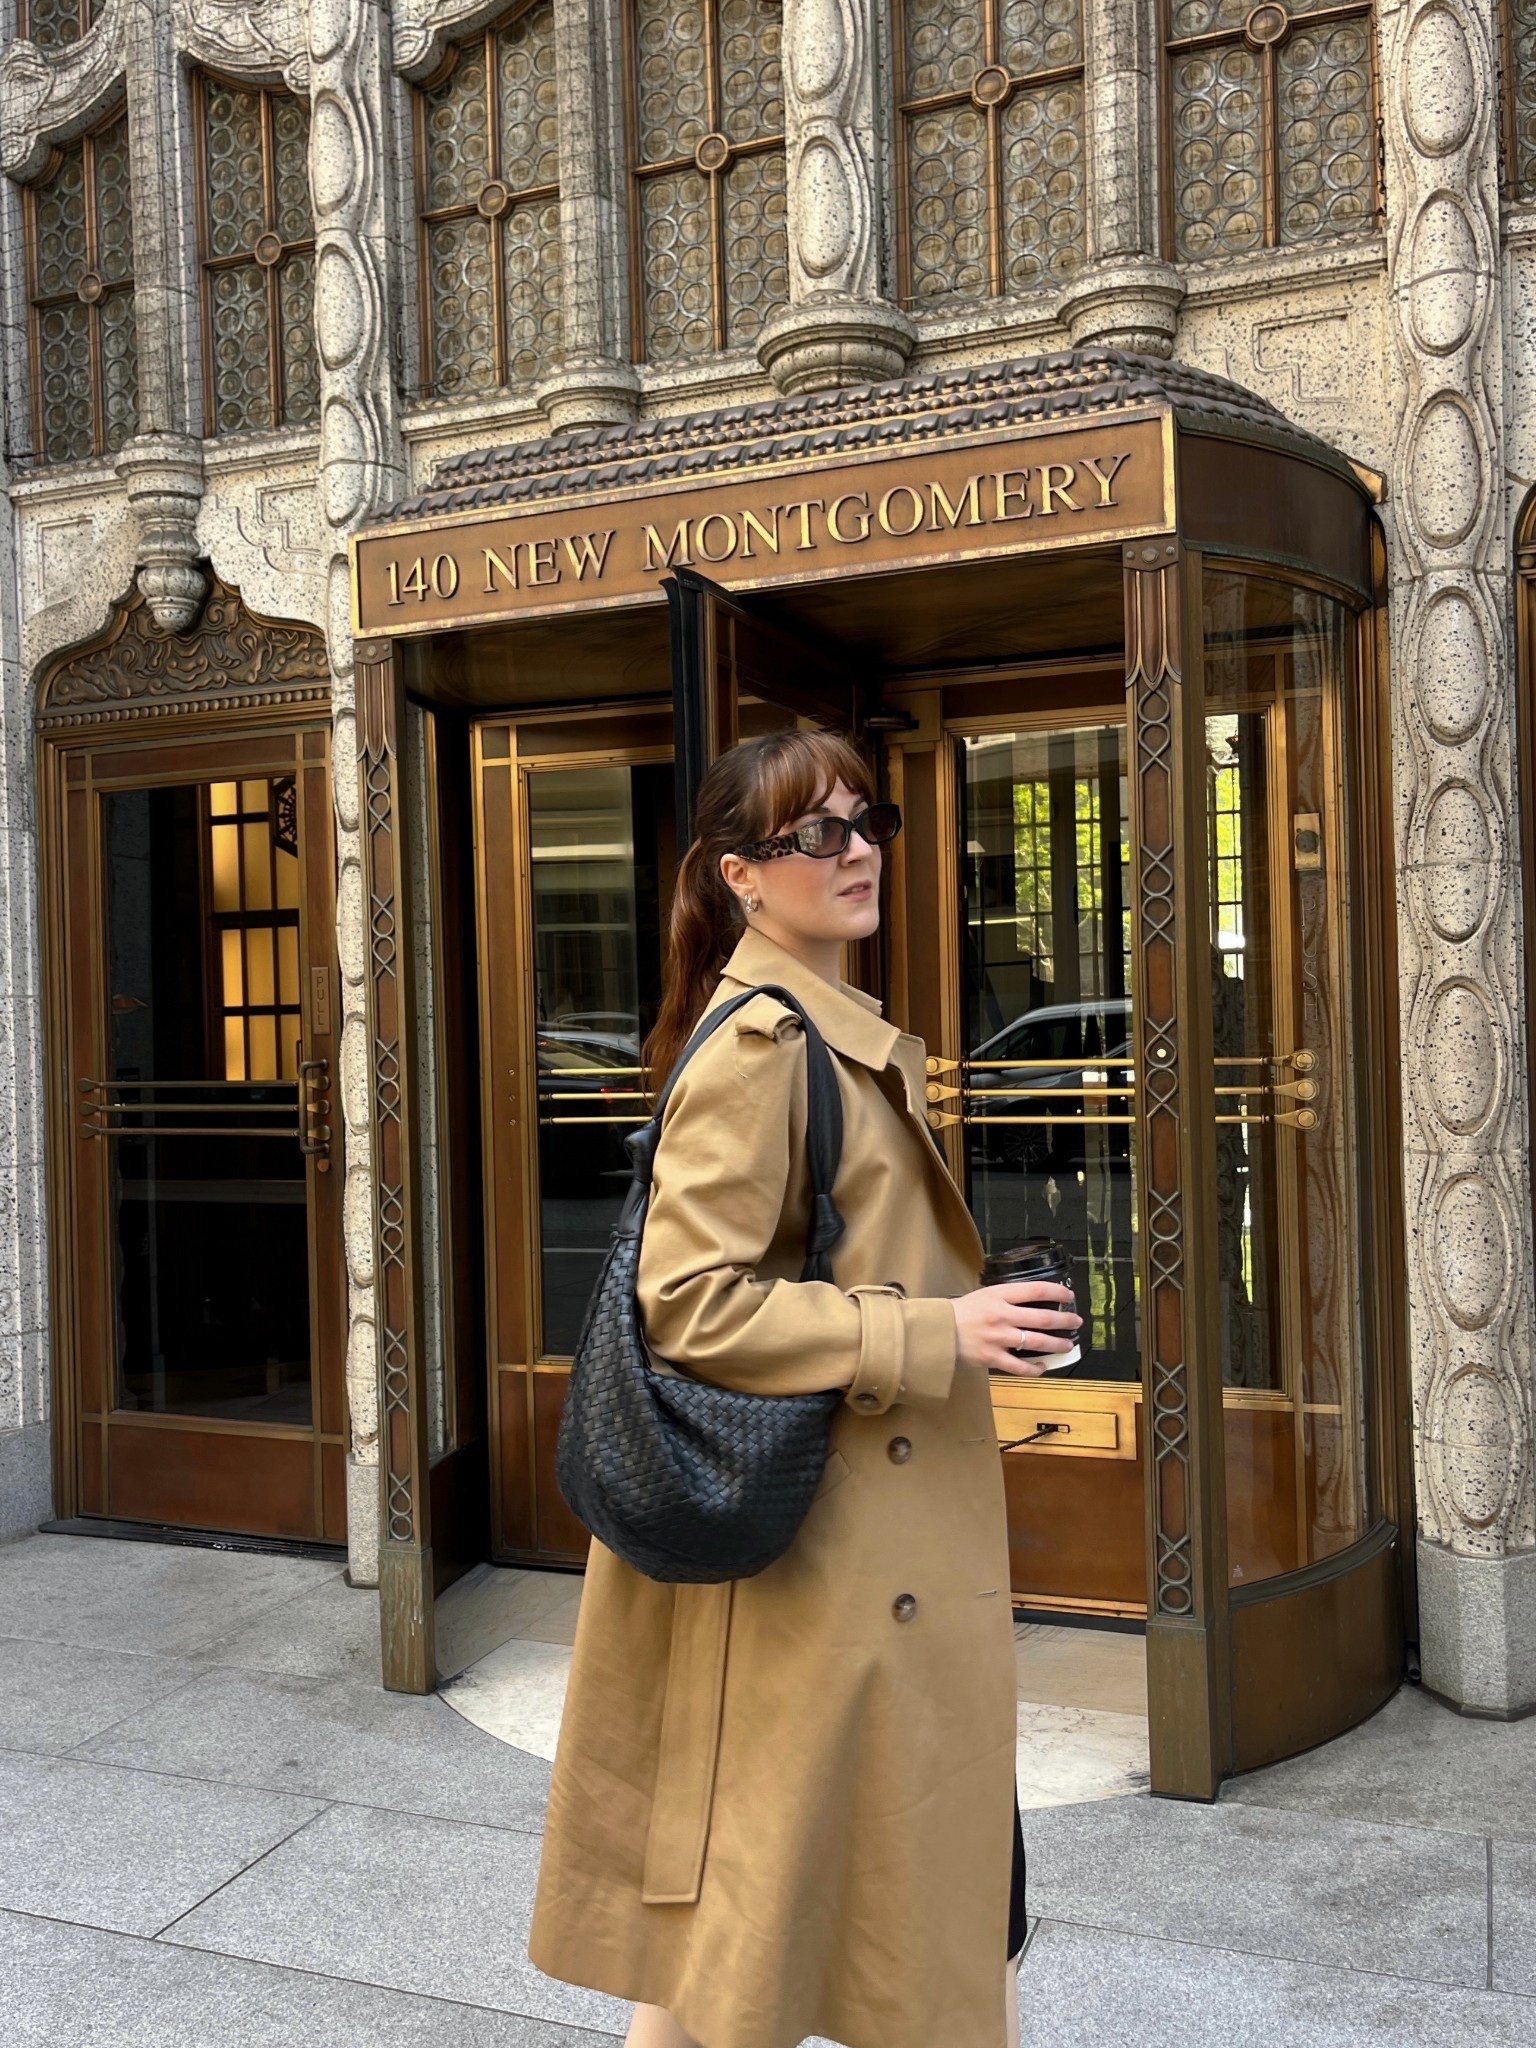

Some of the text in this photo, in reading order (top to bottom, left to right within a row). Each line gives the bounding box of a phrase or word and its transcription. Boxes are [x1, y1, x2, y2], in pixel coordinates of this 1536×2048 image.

[386, 452, 1131, 606] 140 NEW MONTGOMERY
[316, 976, 326, 1026] PULL
[1301, 897, 1319, 1021] PUSH
